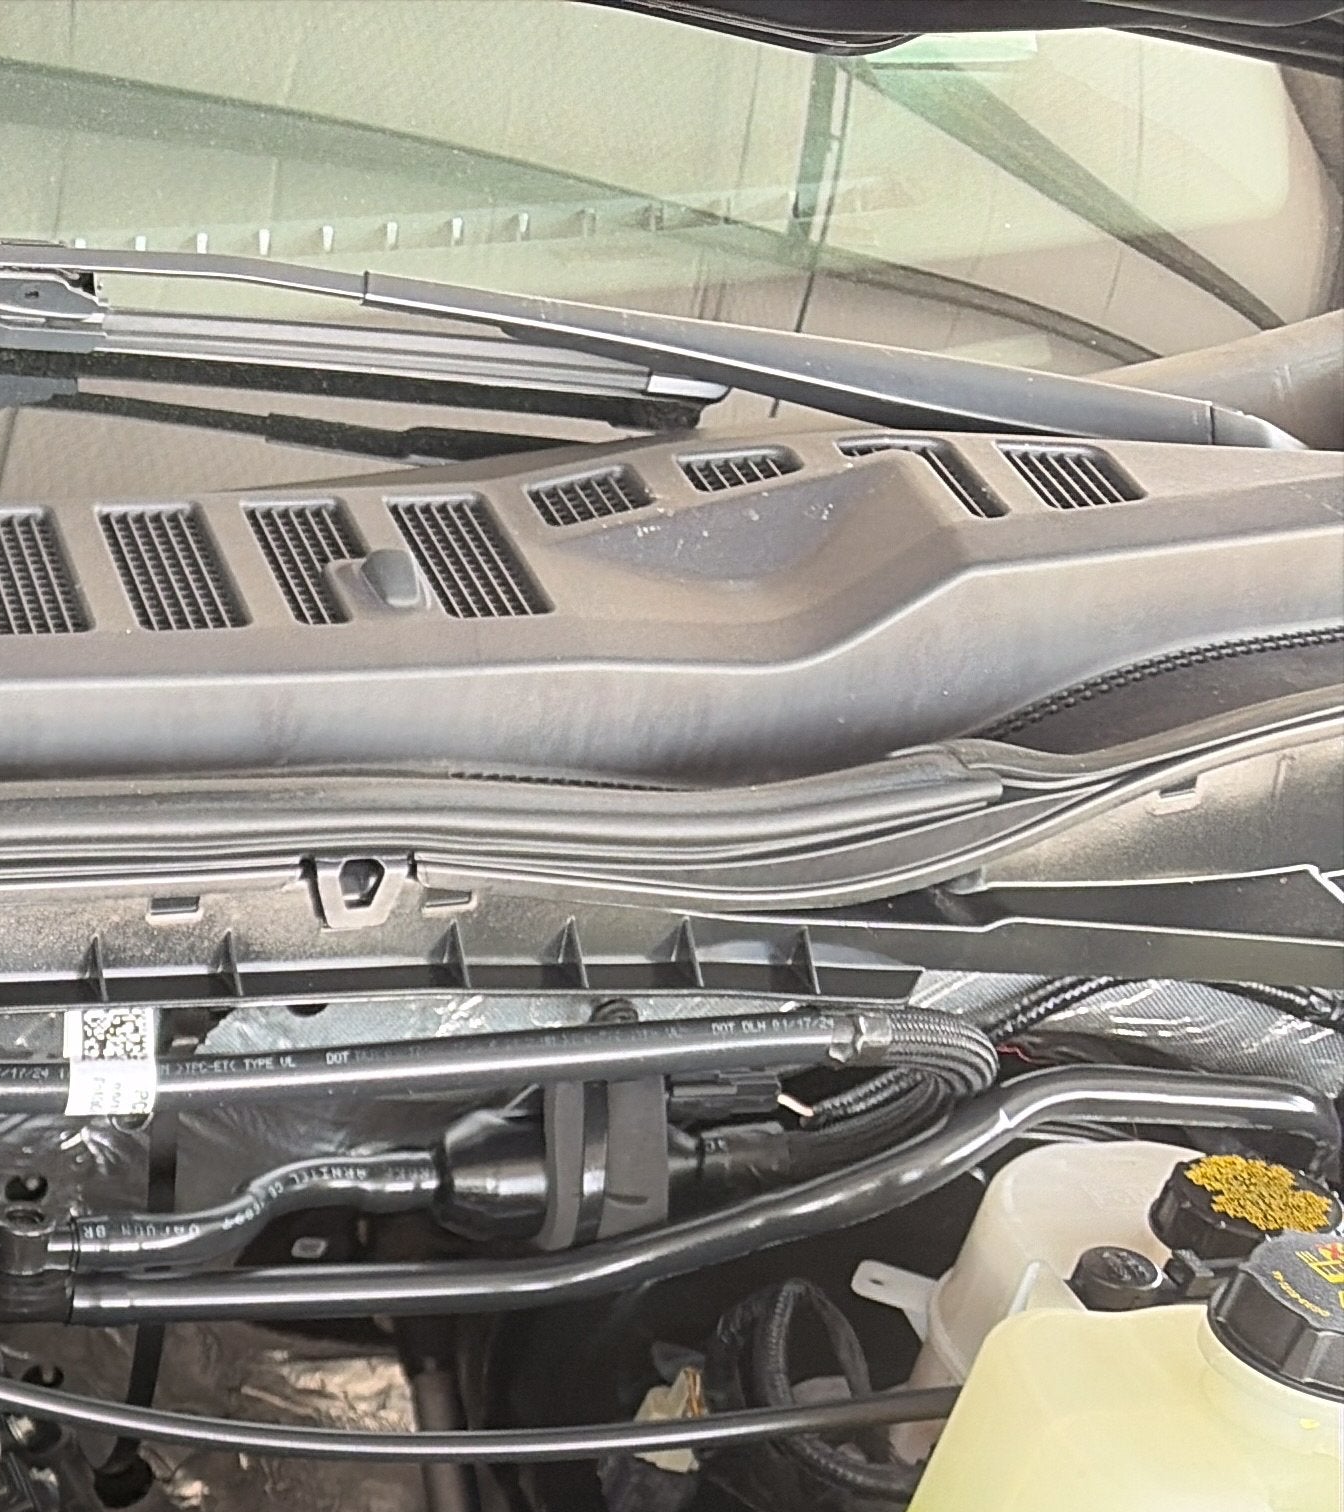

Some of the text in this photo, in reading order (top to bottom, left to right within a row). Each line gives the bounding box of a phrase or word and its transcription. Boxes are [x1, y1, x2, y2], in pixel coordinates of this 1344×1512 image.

[711, 1022, 735, 1036] DOT
[243, 1058, 274, 1071] TYPE
[325, 1052, 350, 1065] DOT
